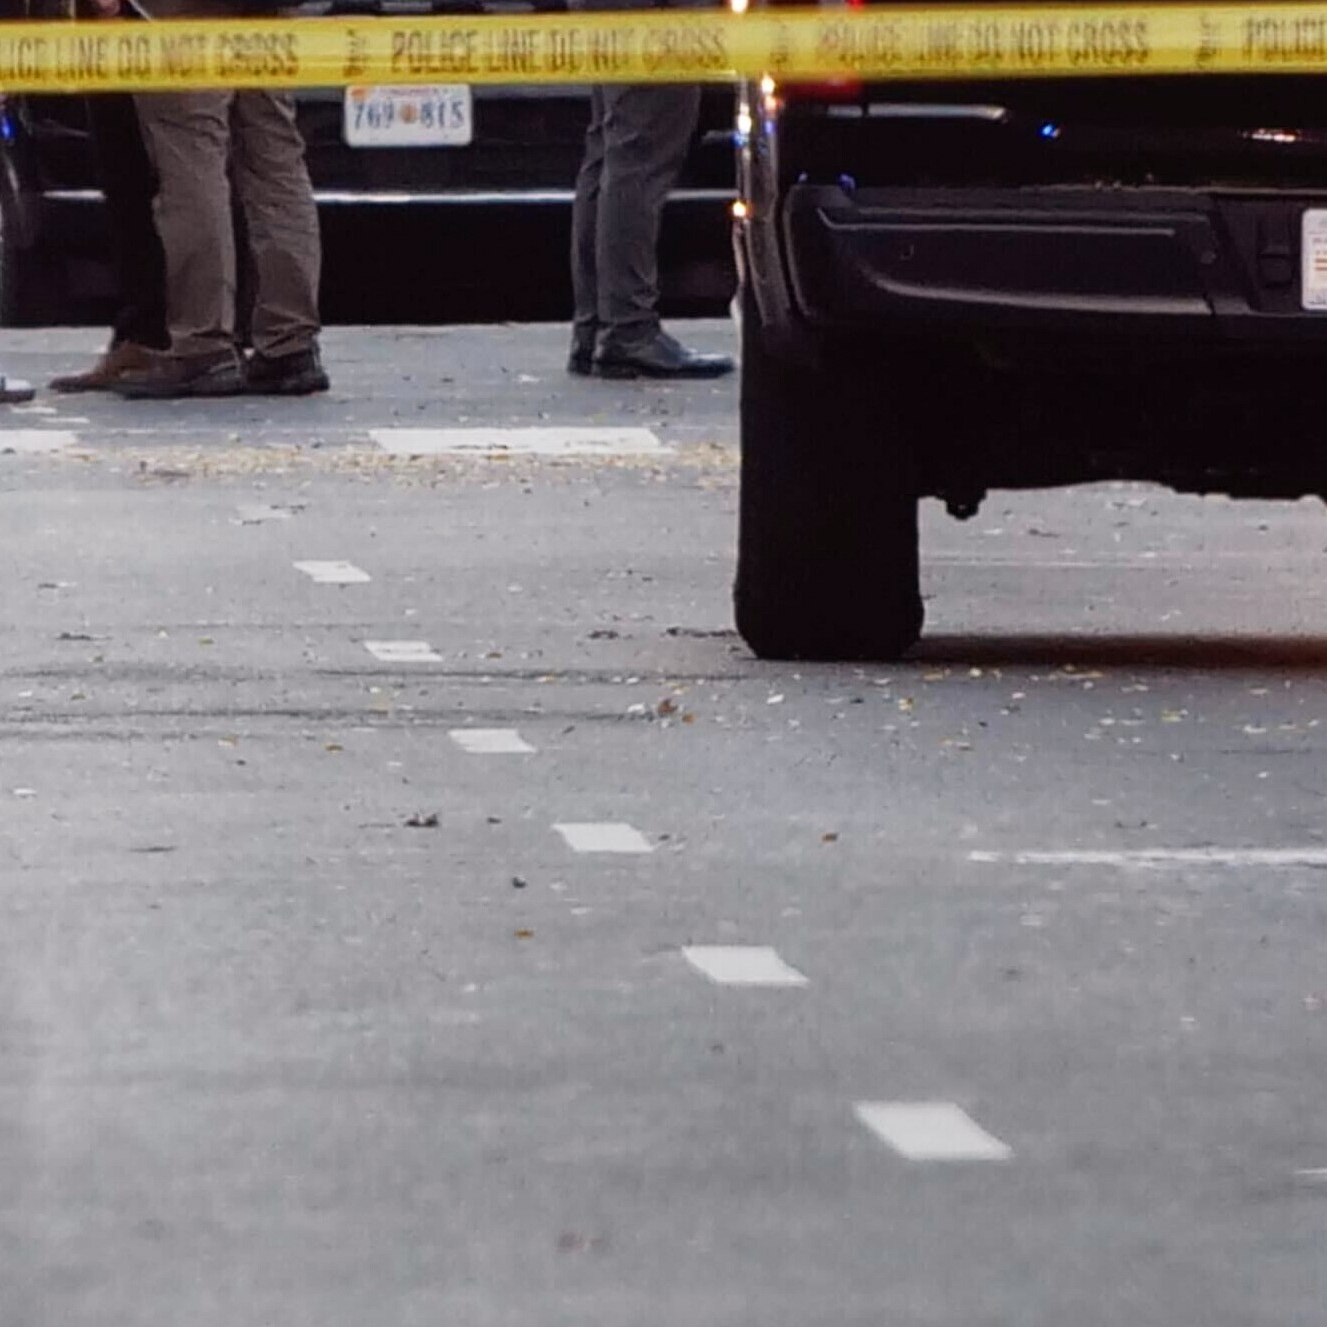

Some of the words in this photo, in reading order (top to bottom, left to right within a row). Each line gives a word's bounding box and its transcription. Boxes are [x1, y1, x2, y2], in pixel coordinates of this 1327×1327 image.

[55, 36, 108, 79] LINE
[117, 35, 152, 78] DO
[160, 35, 210, 77] NOT
[216, 34, 299, 76] CROSS
[391, 31, 478, 73] POLICE
[483, 30, 542, 72] LINE
[550, 29, 583, 71] DO
[591, 29, 635, 71] NOT
[645, 28, 728, 70] CROSS
[1012, 20, 1056, 63] NOT
[1066, 19, 1148, 62] CROSS
